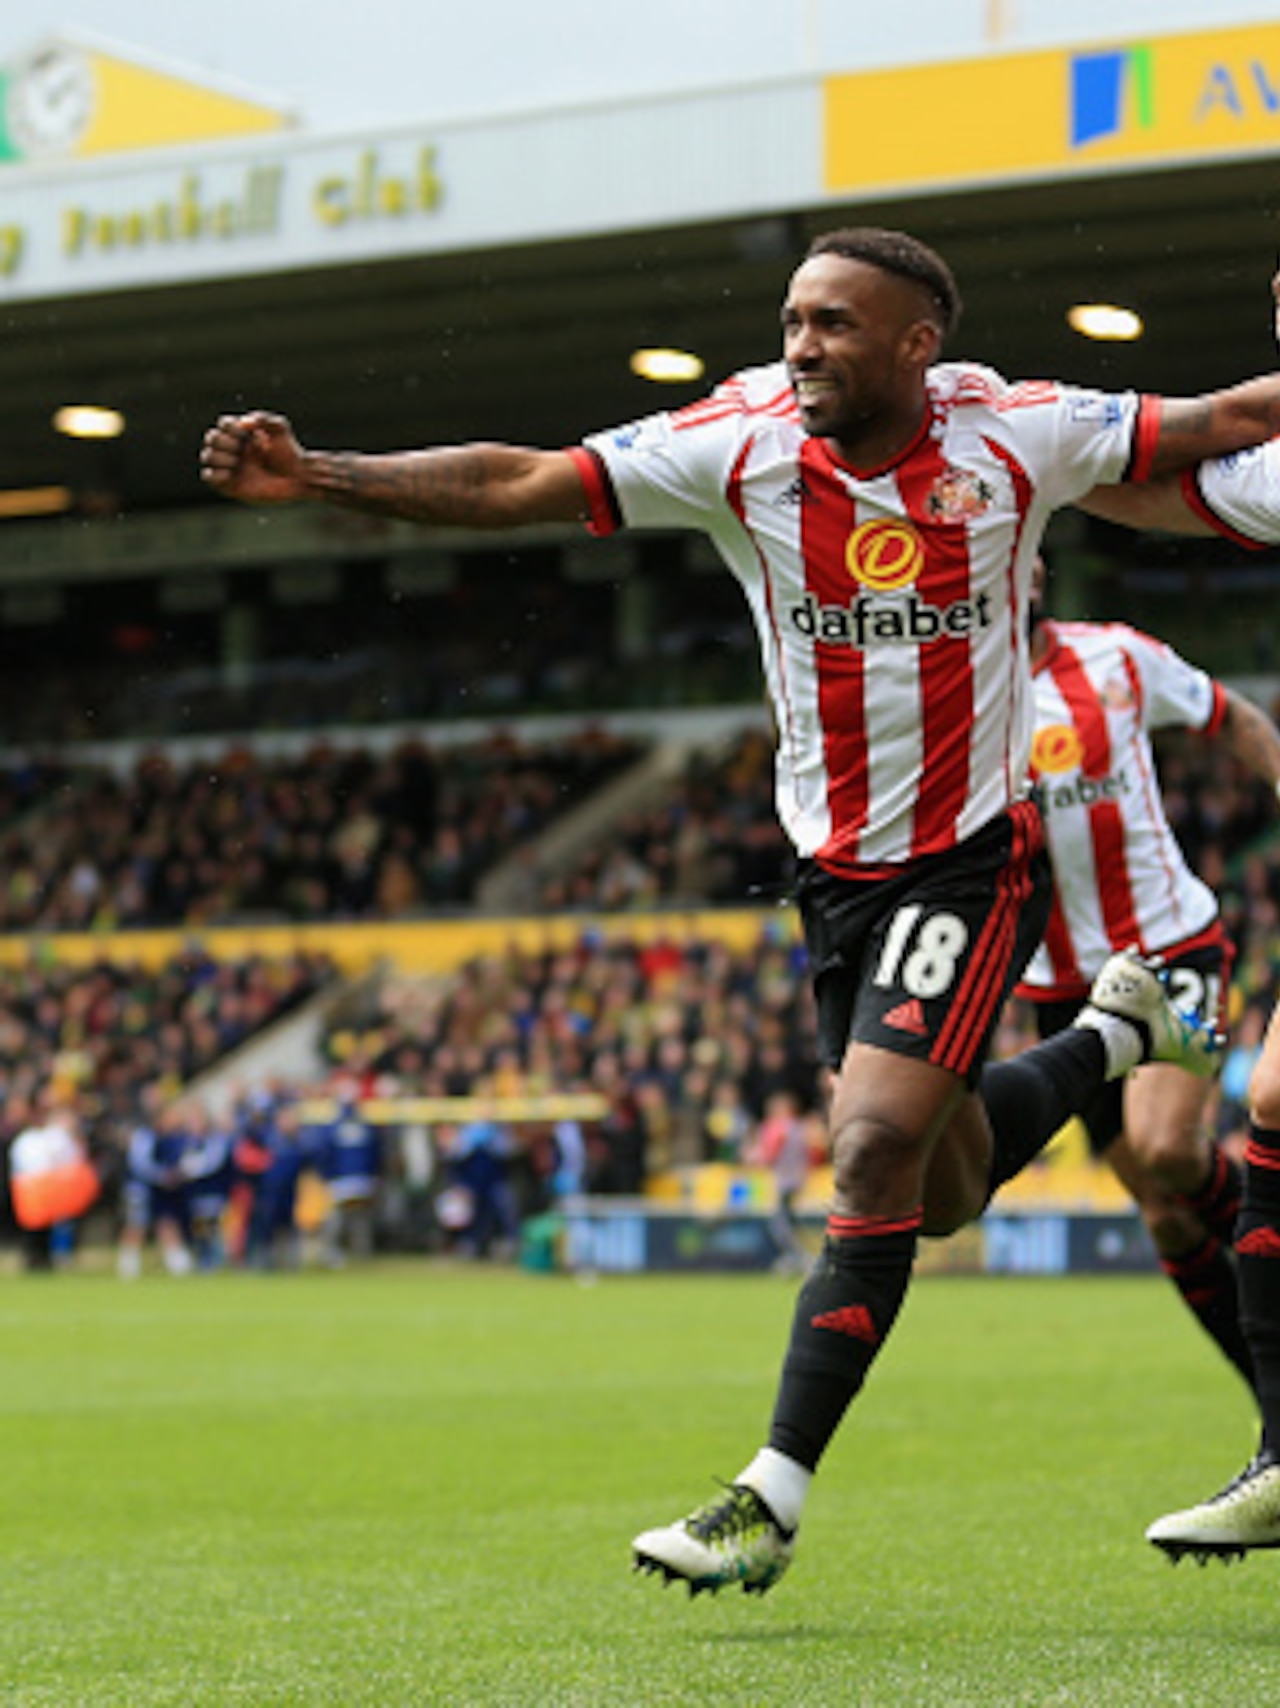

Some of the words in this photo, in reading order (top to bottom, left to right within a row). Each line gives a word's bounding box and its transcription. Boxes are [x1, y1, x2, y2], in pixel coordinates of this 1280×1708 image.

[313, 145, 445, 227] Club
[792, 592, 990, 645] dafabet
[873, 903, 968, 999] 18
